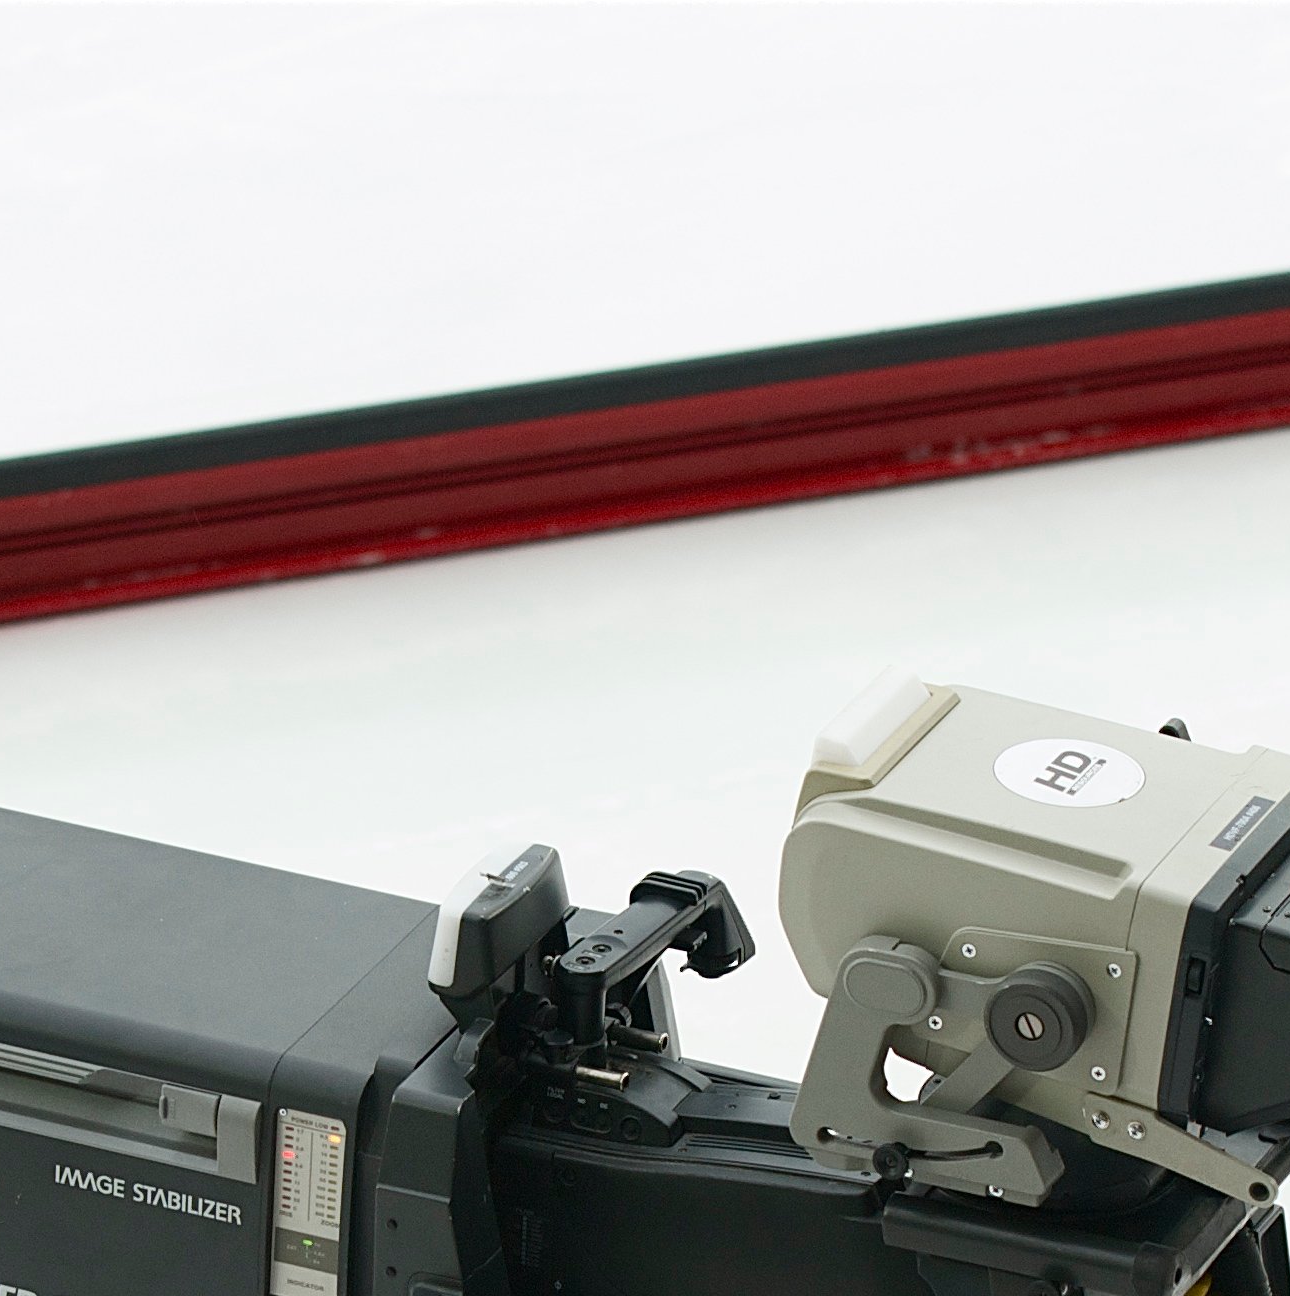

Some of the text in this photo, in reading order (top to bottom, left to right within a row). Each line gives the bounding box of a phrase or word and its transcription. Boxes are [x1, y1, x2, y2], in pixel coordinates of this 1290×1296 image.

[1033, 750, 1091, 792] HD
[54, 1164, 242, 1226] IMAGE STABILIZER
